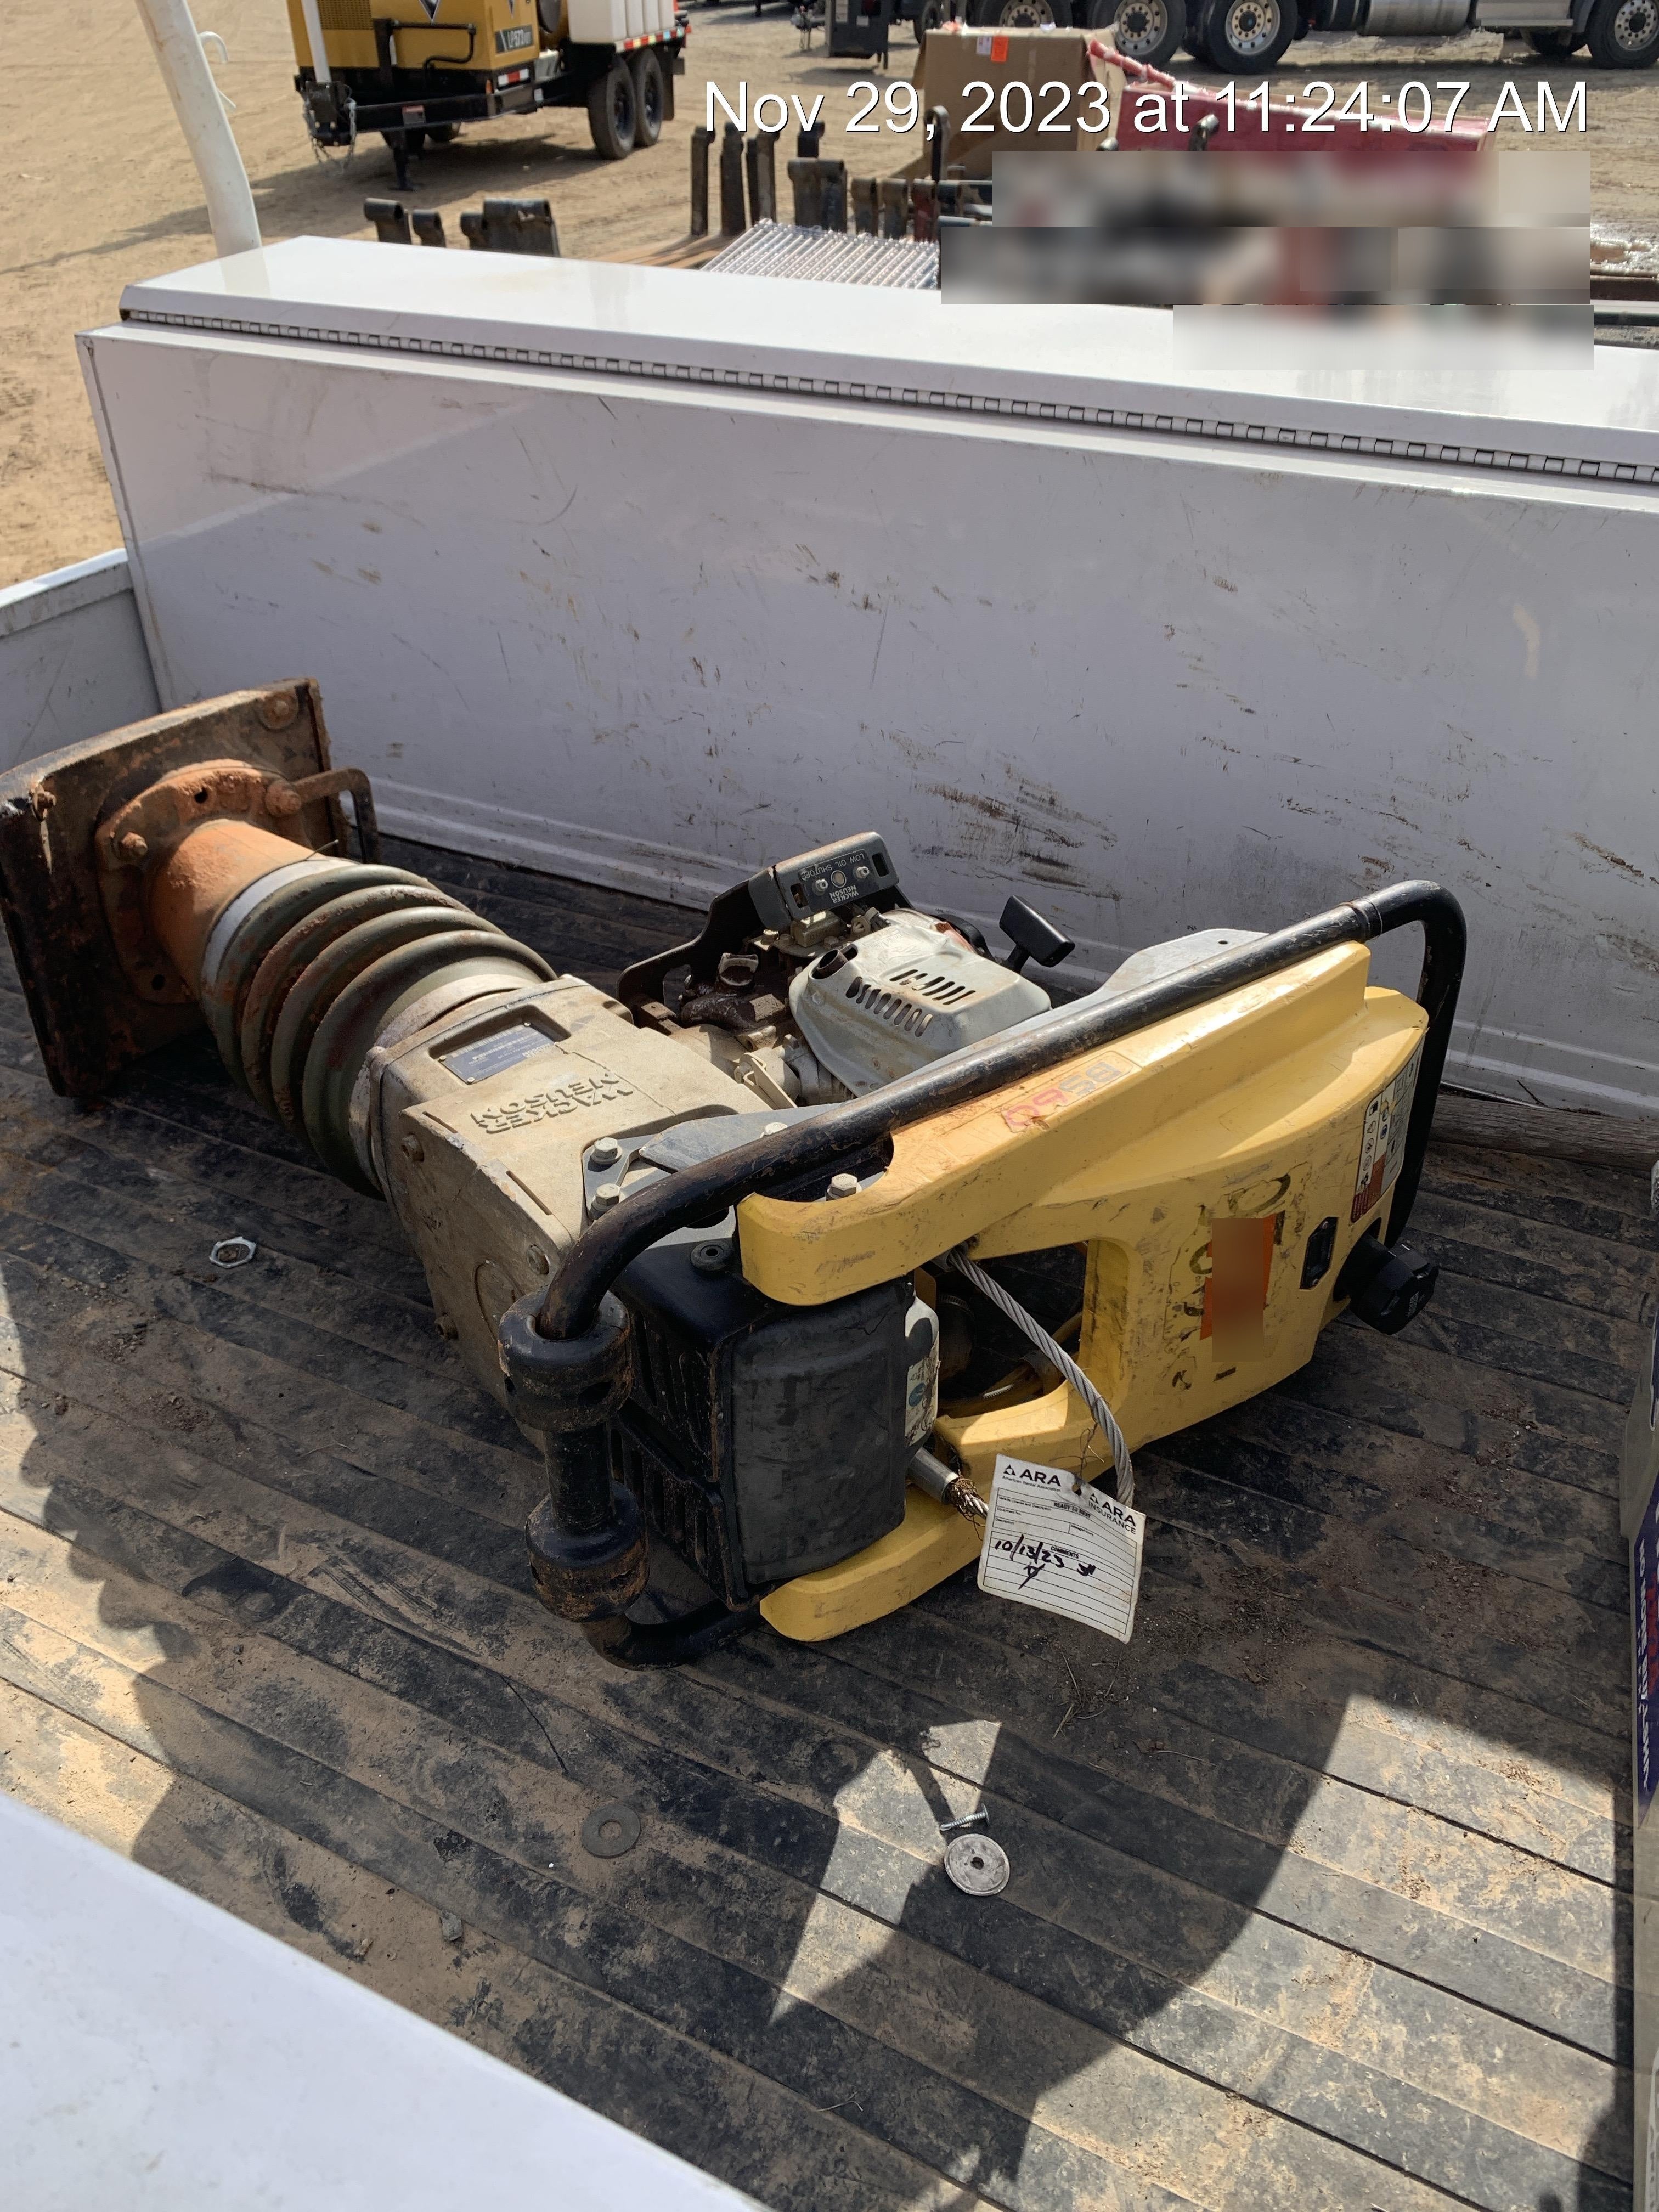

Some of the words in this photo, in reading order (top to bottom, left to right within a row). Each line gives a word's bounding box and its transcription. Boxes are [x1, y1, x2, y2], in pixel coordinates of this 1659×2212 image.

[835, 859, 847, 868] OIL
[850, 853, 865, 864] LOW
[801, 864, 832, 881] SHUTOFF
[830, 885, 856, 900] NEUSON
[833, 890, 859, 904] WACKER
[470, 1073, 619, 1125] NEUSON
[478, 1087, 633, 1134] WACKER
[1002, 1475, 1022, 1483] American
[1019, 1469, 1062, 1487] ARA
[997, 1507, 1015, 1515] Equipment
[1053, 1502, 1070, 1510] READY
[995, 1517, 1014, 1525] Description
[1088, 1501, 1136, 1534] INSURANCE
[1102, 1501, 1136, 1527] ARA
[995, 1534, 1065, 1568] 10/13/23
[1051, 1545, 1080, 1559] COMMENTS
[1639, 1538, 1645, 1578] NO
